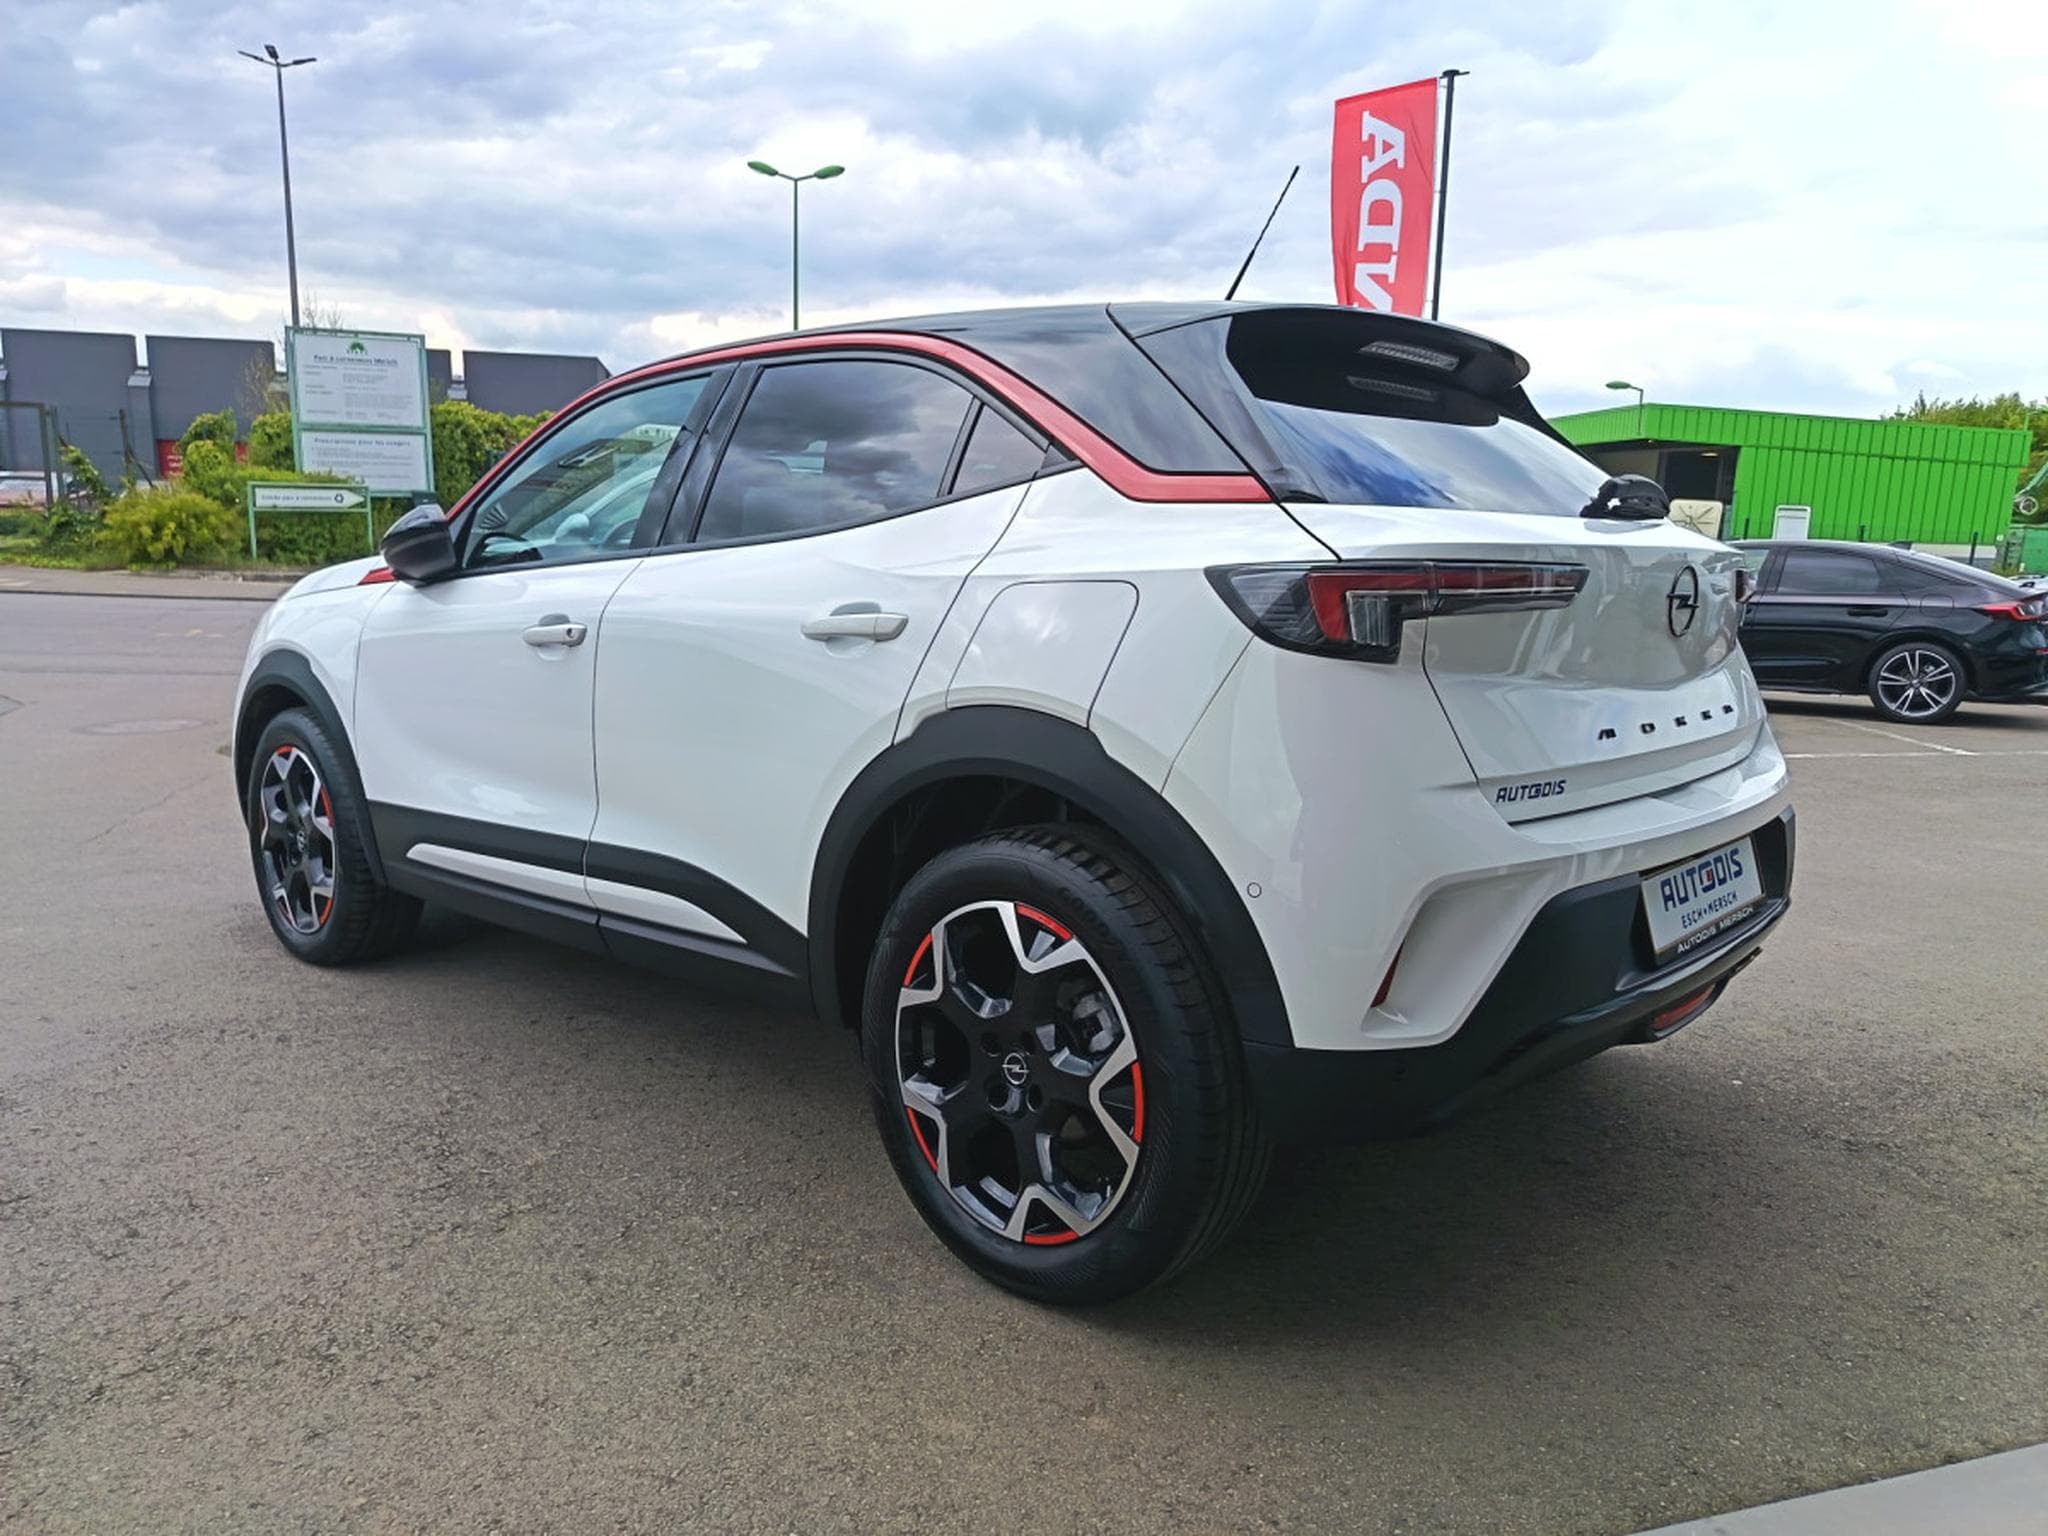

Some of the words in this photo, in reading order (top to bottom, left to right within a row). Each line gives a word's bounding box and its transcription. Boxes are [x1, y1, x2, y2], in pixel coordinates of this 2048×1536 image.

[1598, 704, 1734, 741] MOKKA
[1495, 780, 1567, 803] AUTODIS
[1660, 847, 1744, 912] AUTODIS
